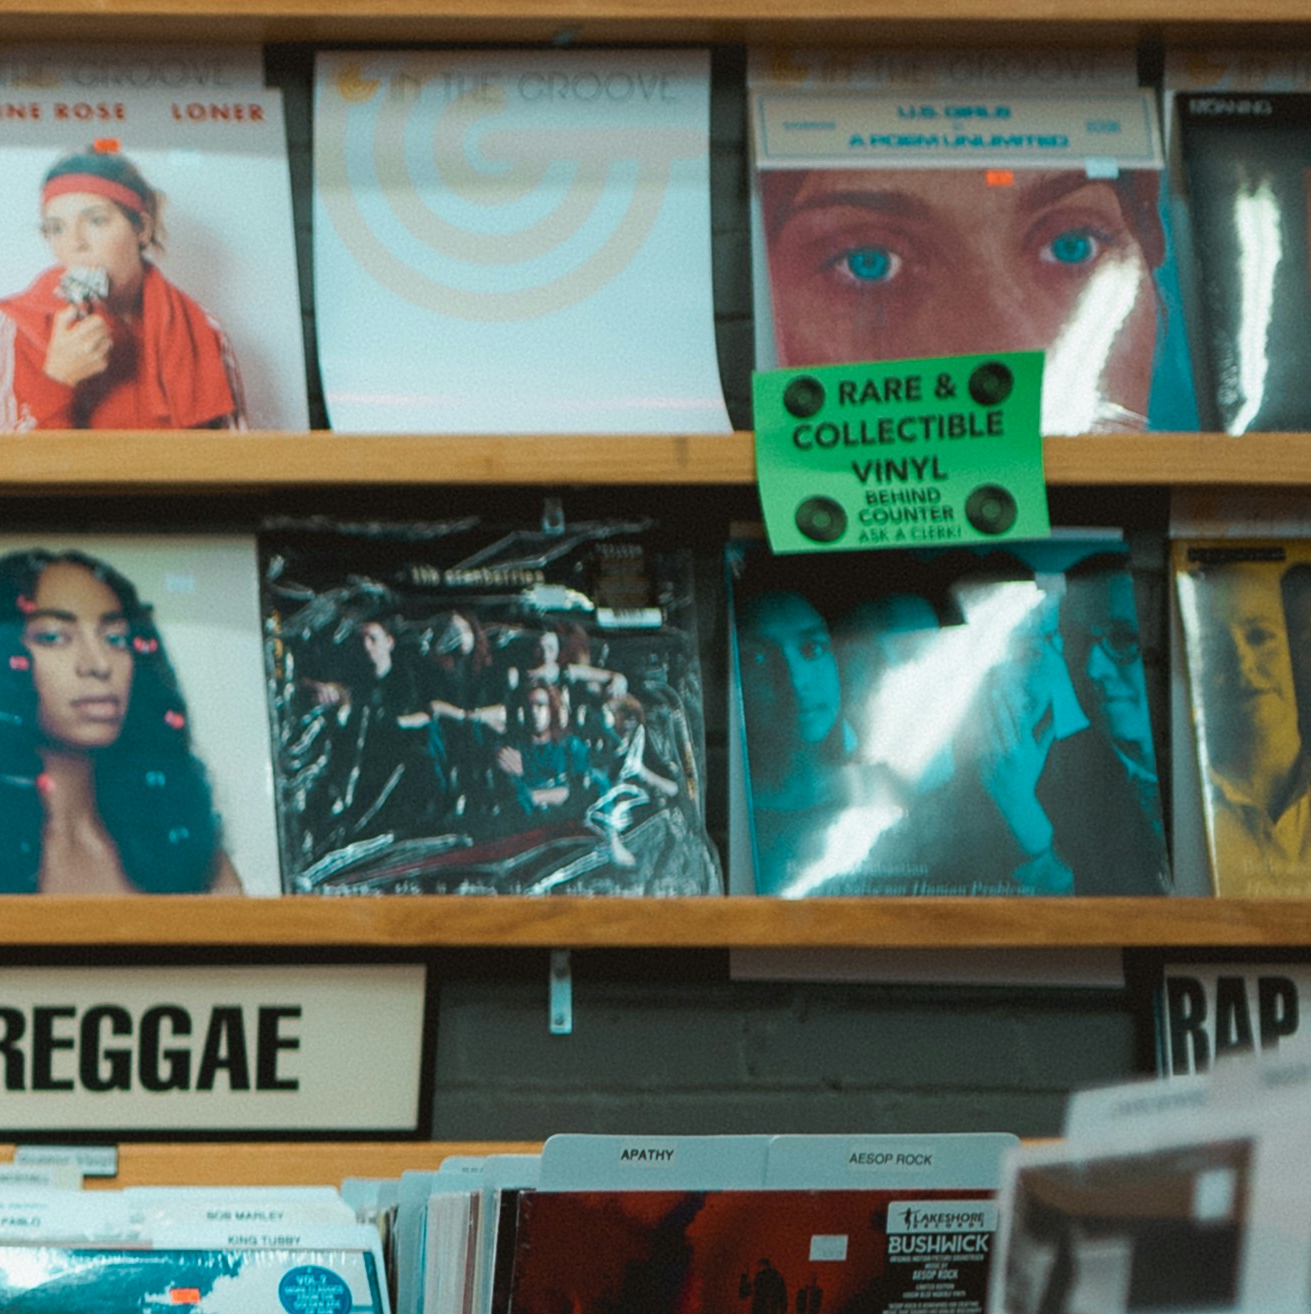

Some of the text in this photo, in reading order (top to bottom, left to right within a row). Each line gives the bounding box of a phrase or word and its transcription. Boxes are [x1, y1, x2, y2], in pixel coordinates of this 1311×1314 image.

[517, 72, 676, 101] GROOVE
[54, 102, 126, 121] ROSE
[171, 102, 265, 121] LONER
[838, 373, 957, 406] RARE &
[792, 410, 1005, 450] COLLECTIBLE
[851, 455, 948, 484] VINYL
[865, 486, 941, 506] BEHIND
[858, 505, 954, 527] COUNTER
[620, 1149, 674, 1162] APATHY
[849, 1152, 933, 1167] AESOP ROCK
[235, 1211, 284, 1221] MARLEY
[913, 1212, 984, 1224] LAKESHORE
[227, 1234, 301, 1246] KING TUBBY
[887, 1234, 990, 1254] BUSHWICK
[912, 1269, 959, 1280] AESOP ROCK
